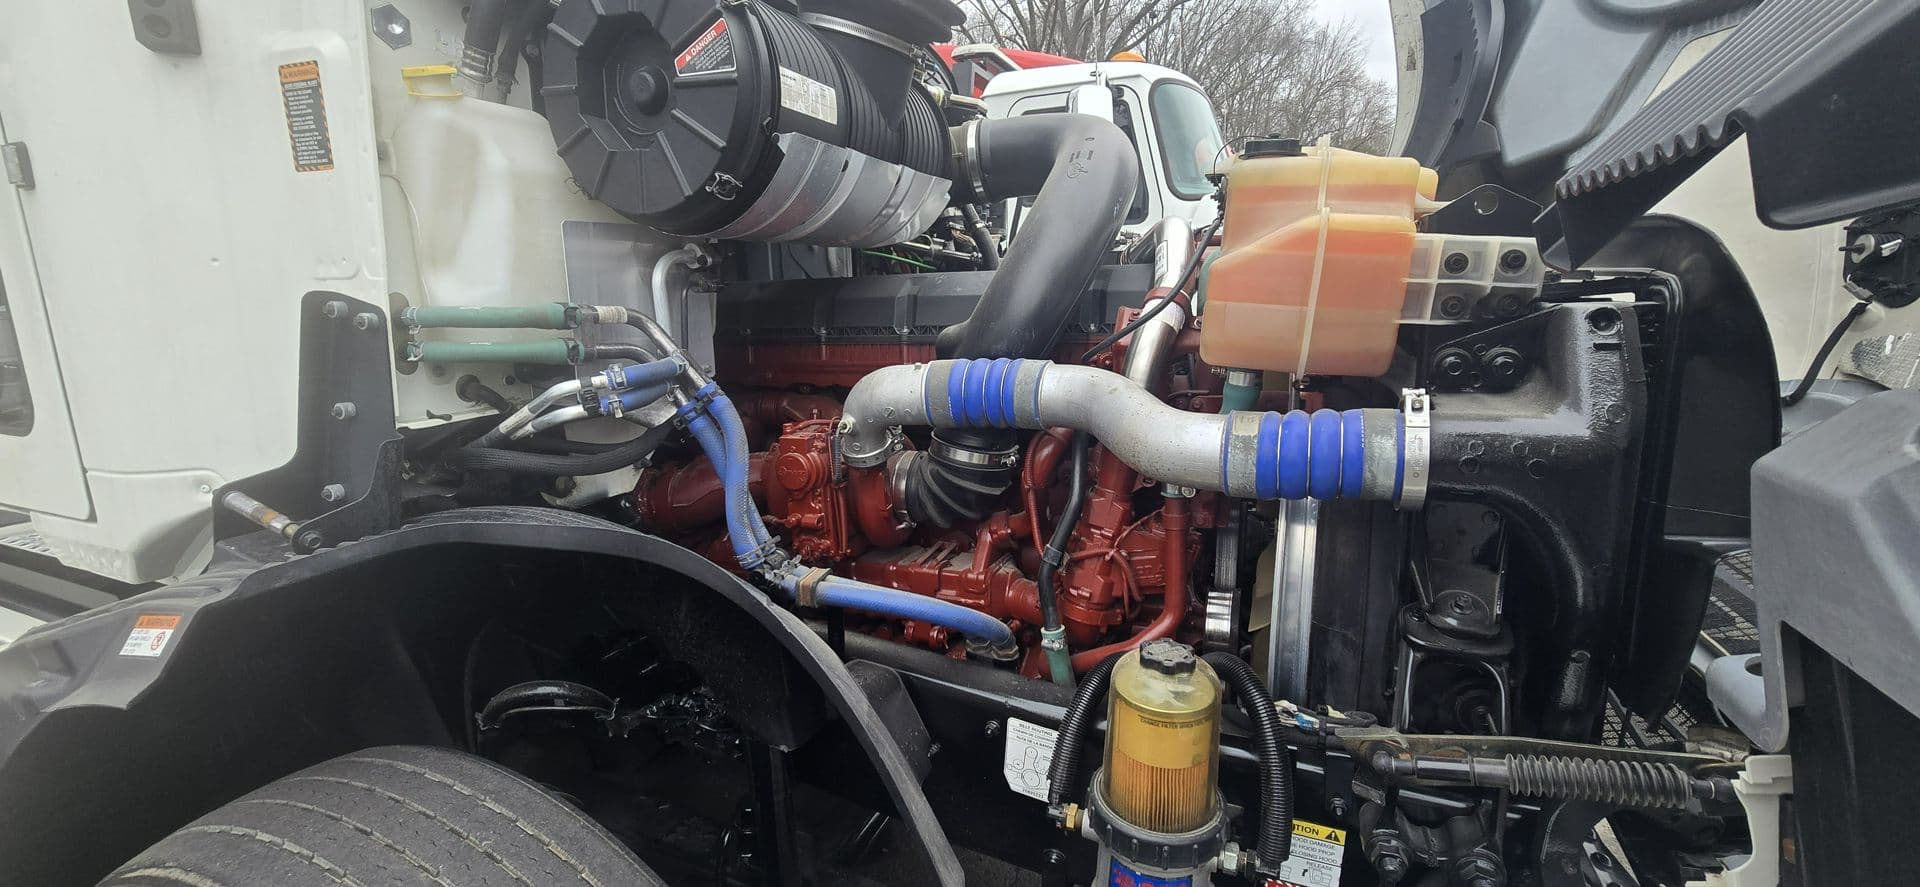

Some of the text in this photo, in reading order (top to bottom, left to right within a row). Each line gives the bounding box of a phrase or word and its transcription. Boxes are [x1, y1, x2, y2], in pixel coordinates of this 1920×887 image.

[691, 30, 717, 56] DANGER
[1032, 727, 1053, 737] ROUTING
[1299, 844, 1317, 853] HOOD
[1309, 840, 1335, 849] DAMAGE
[1318, 855, 1337, 864] HOOD
[1306, 861, 1332, 871] RELEASE
